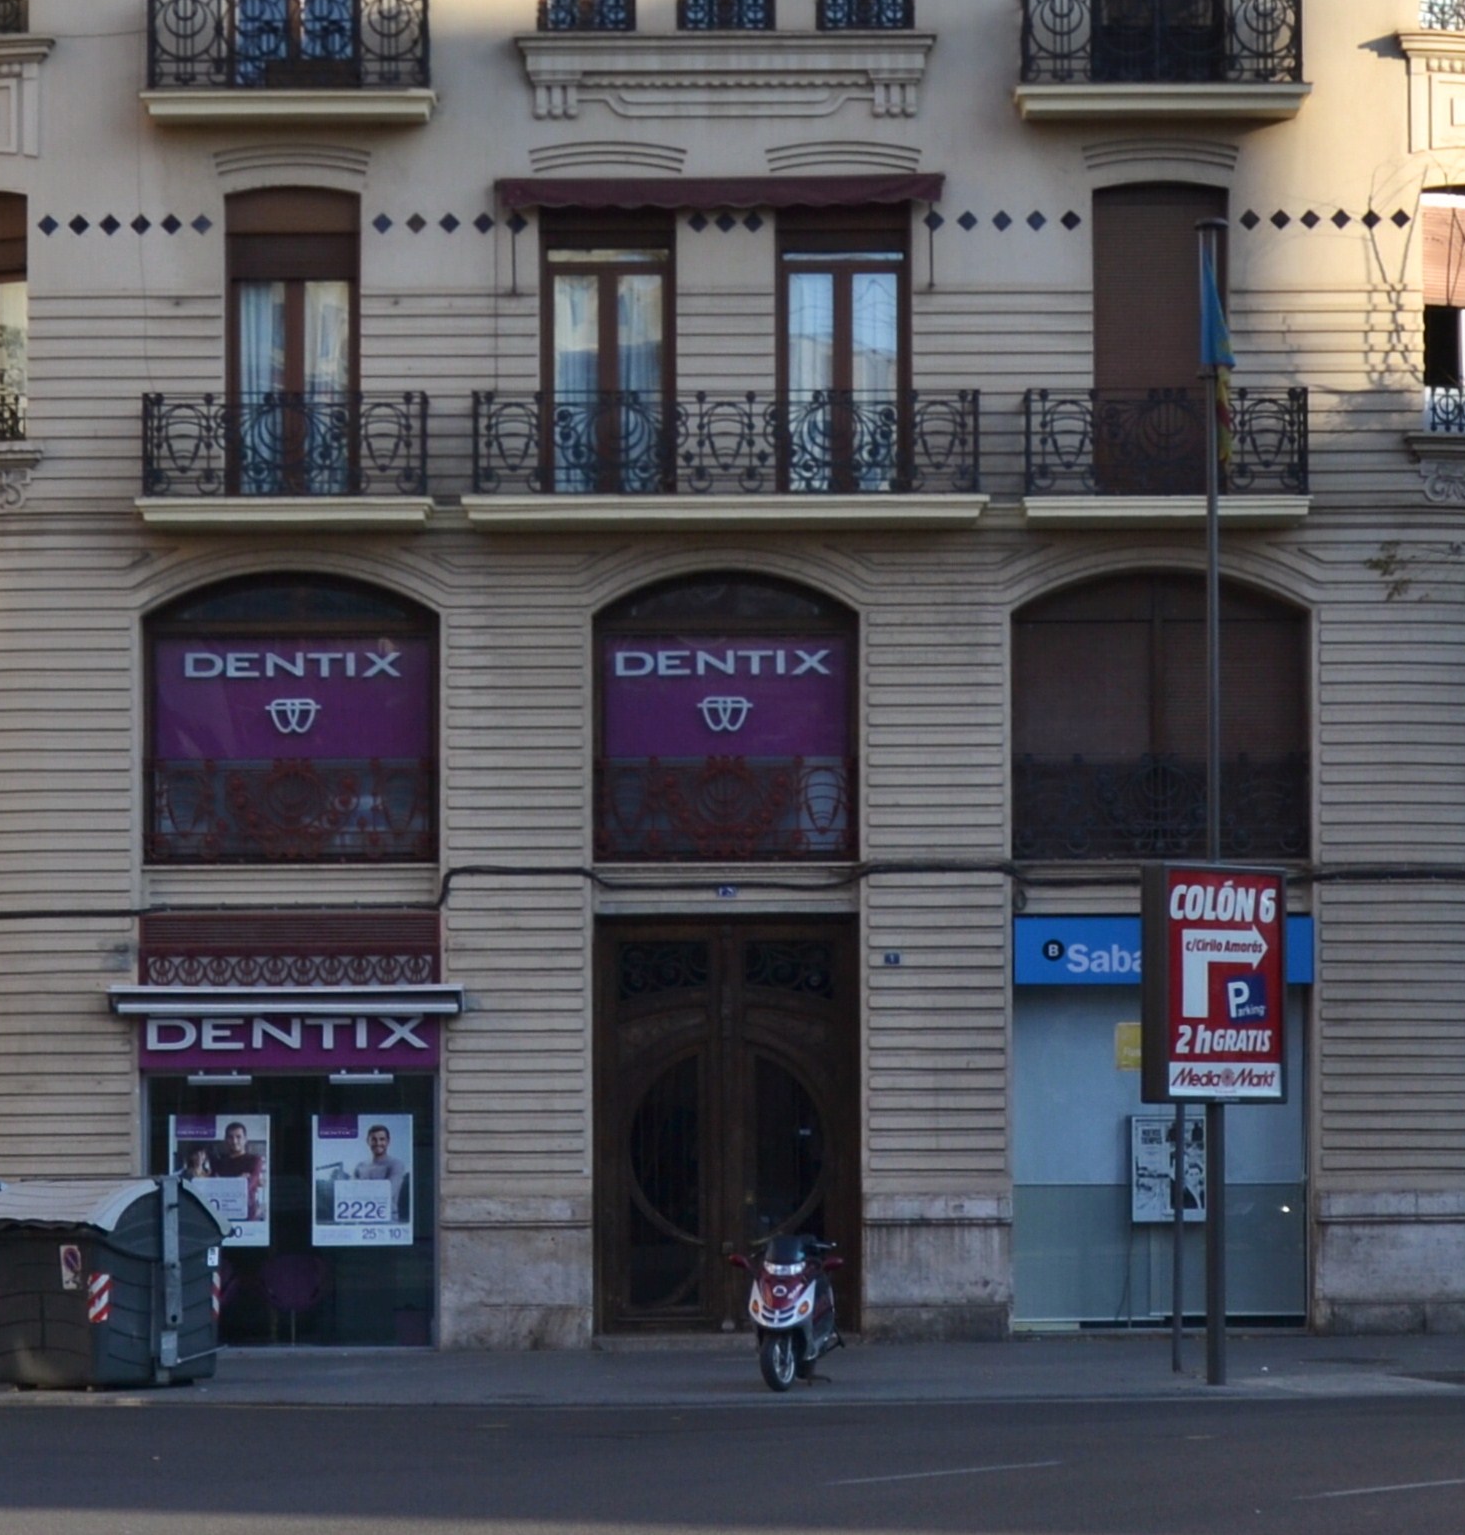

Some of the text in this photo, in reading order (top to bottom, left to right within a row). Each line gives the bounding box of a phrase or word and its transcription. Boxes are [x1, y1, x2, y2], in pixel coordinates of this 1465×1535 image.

[184, 652, 402, 678] DENTIX
[615, 649, 831, 677] DENTIX
[1169, 880, 1277, 924] COLÓN 6
[1185, 939, 1263, 954] c/Cirilo Amorós
[1227, 981, 1266, 1019] Parking
[146, 1016, 430, 1051] DENTIX
[1175, 1024, 1193, 1054] 2
[1213, 1029, 1272, 1052] GRATIS
[1171, 1067, 1275, 1087] Media Markt
[337, 1201, 387, 1219] 222€
